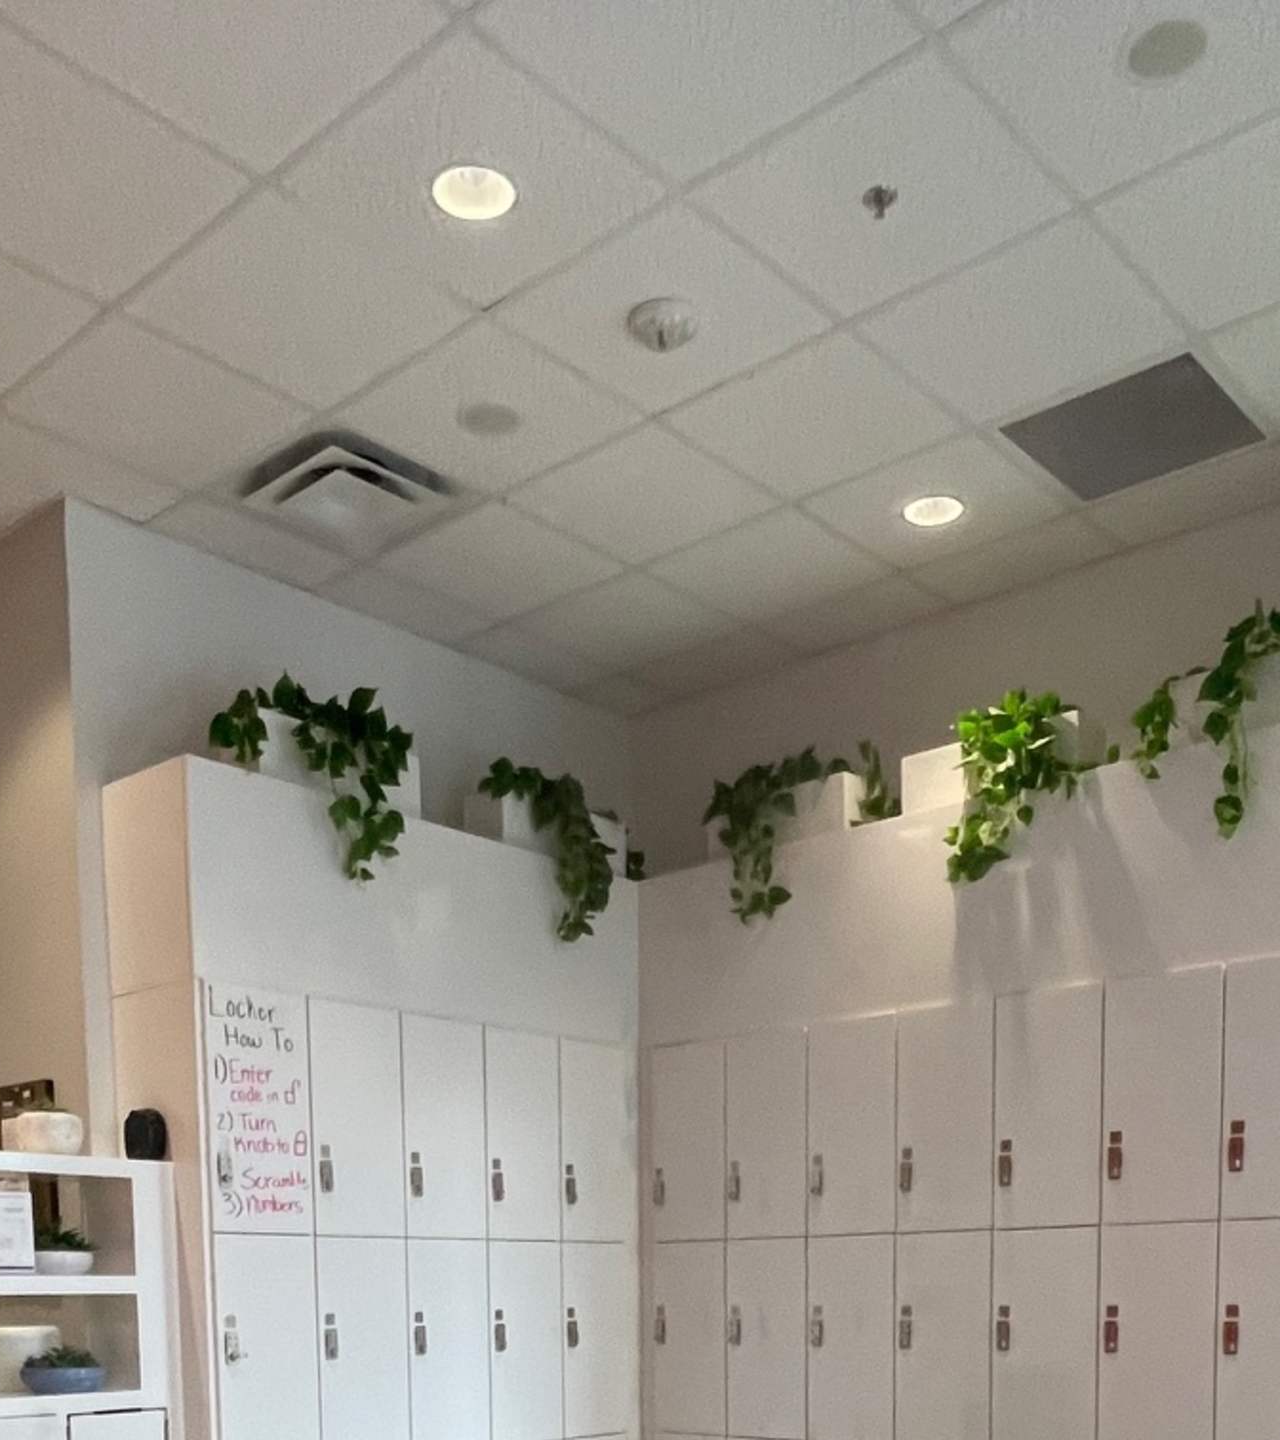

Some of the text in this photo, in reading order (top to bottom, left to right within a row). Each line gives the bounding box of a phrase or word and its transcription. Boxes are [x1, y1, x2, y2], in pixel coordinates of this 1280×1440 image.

[208, 984, 275, 1023] Locker
[224, 1024, 294, 1052] How To
[240, 1112, 277, 1132] Turn
